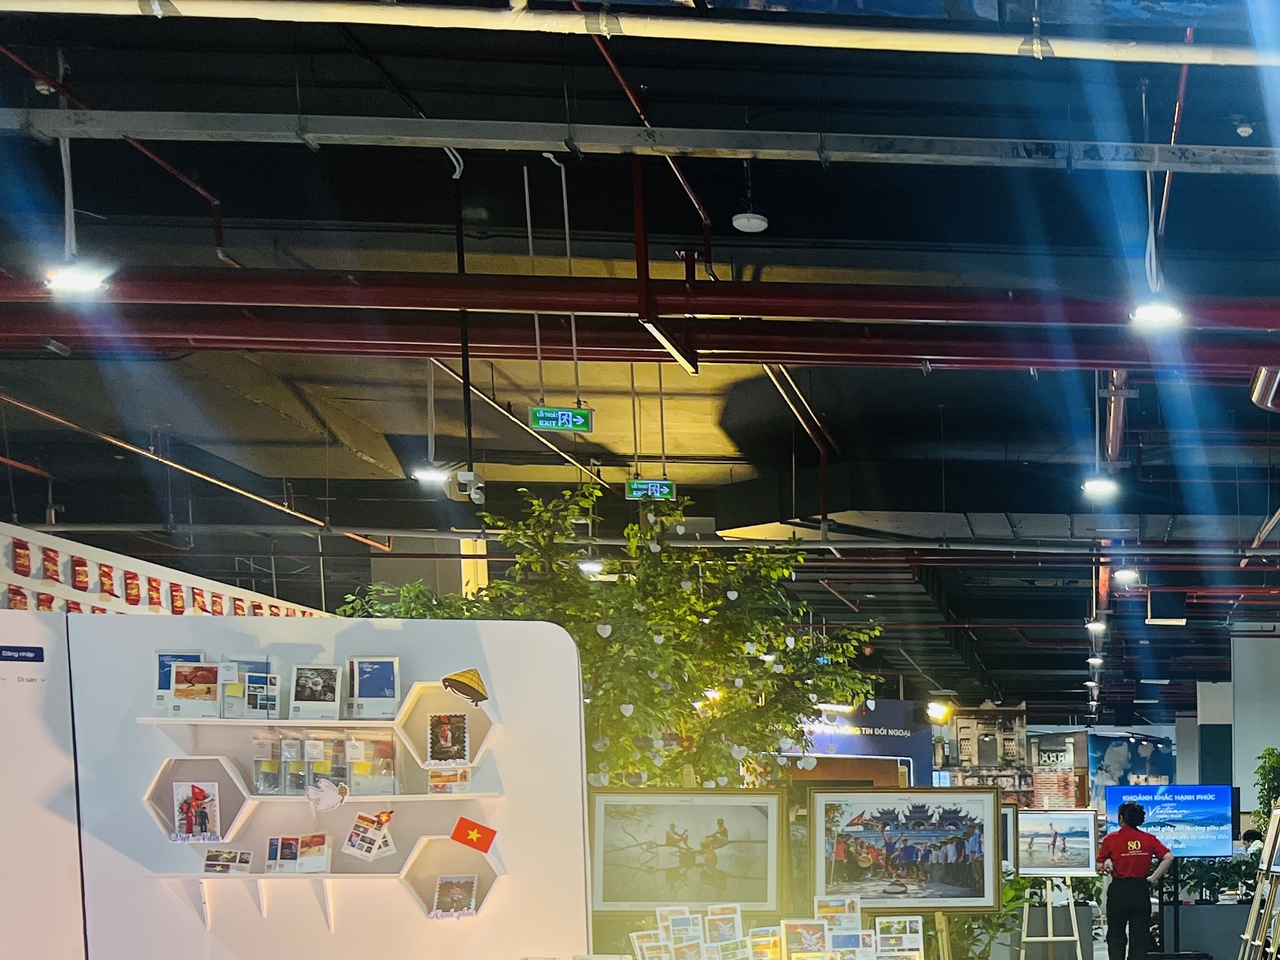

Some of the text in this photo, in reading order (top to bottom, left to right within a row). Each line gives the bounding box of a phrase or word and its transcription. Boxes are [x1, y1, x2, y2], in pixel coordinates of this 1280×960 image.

[861, 727, 873, 735] TIN
[874, 726, 887, 735] ĐỐI
[888, 728, 911, 738] NGOẠI
[1127, 840, 1141, 850] 80
